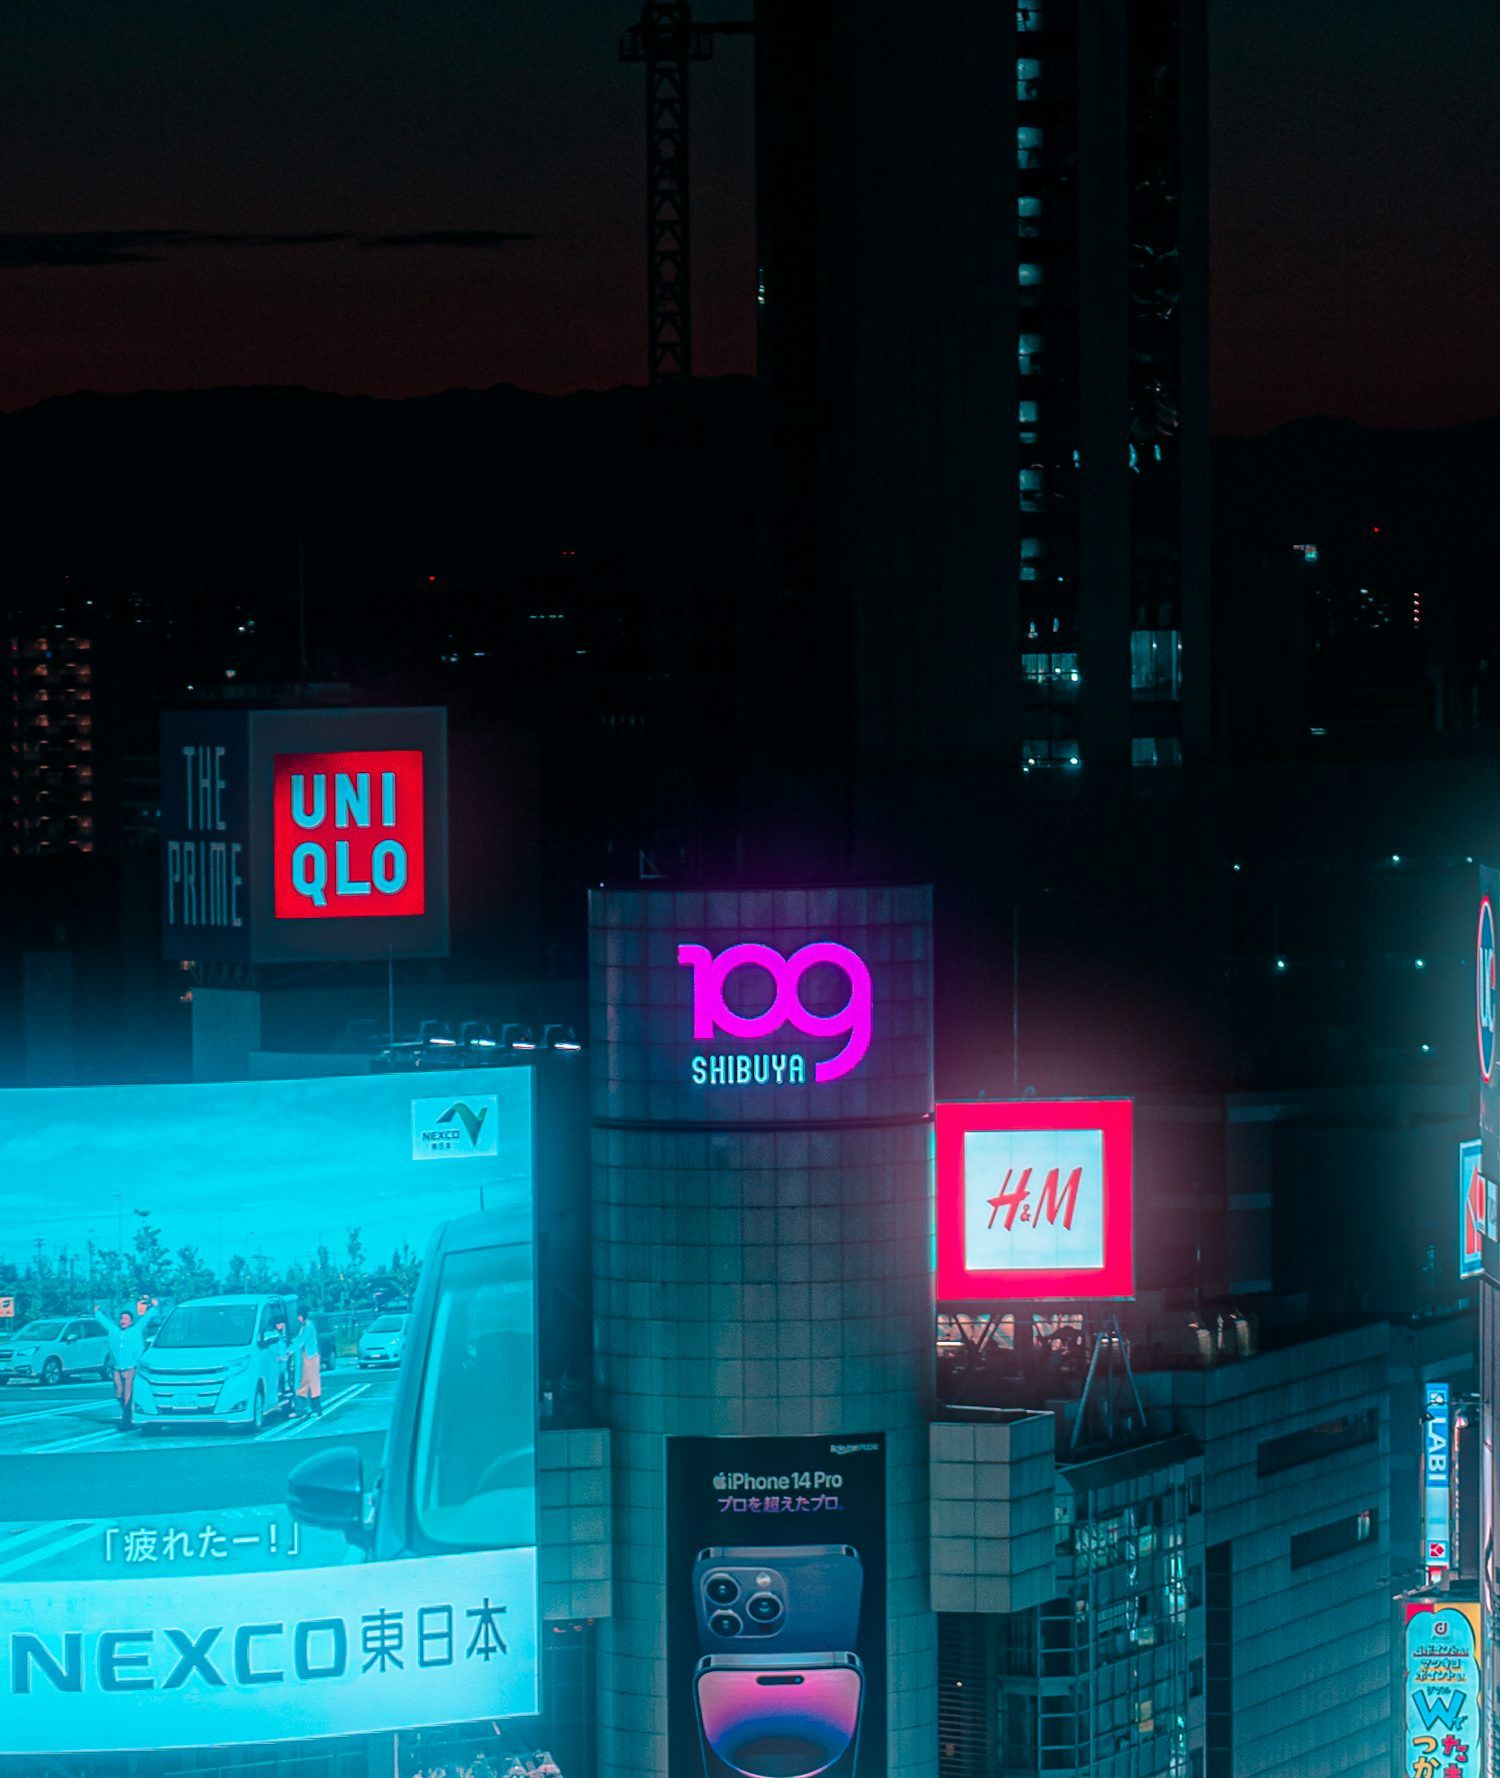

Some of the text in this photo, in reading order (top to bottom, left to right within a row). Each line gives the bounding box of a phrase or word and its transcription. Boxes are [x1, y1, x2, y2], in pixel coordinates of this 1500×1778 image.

[182, 745, 227, 830] THE
[290, 771, 398, 828] UNI
[168, 843, 244, 929] PRIME
[290, 838, 408, 907] QLO
[677, 942, 873, 1082] 109
[692, 1054, 805, 1085] SHIBUYA
[987, 1167, 1083, 1231] H&M
[727, 1471, 843, 1491] iPhone 14 Pro
[1427, 1415, 1447, 1483] LABI
[718, 1495, 845, 1514] プロを超えたプロ。
